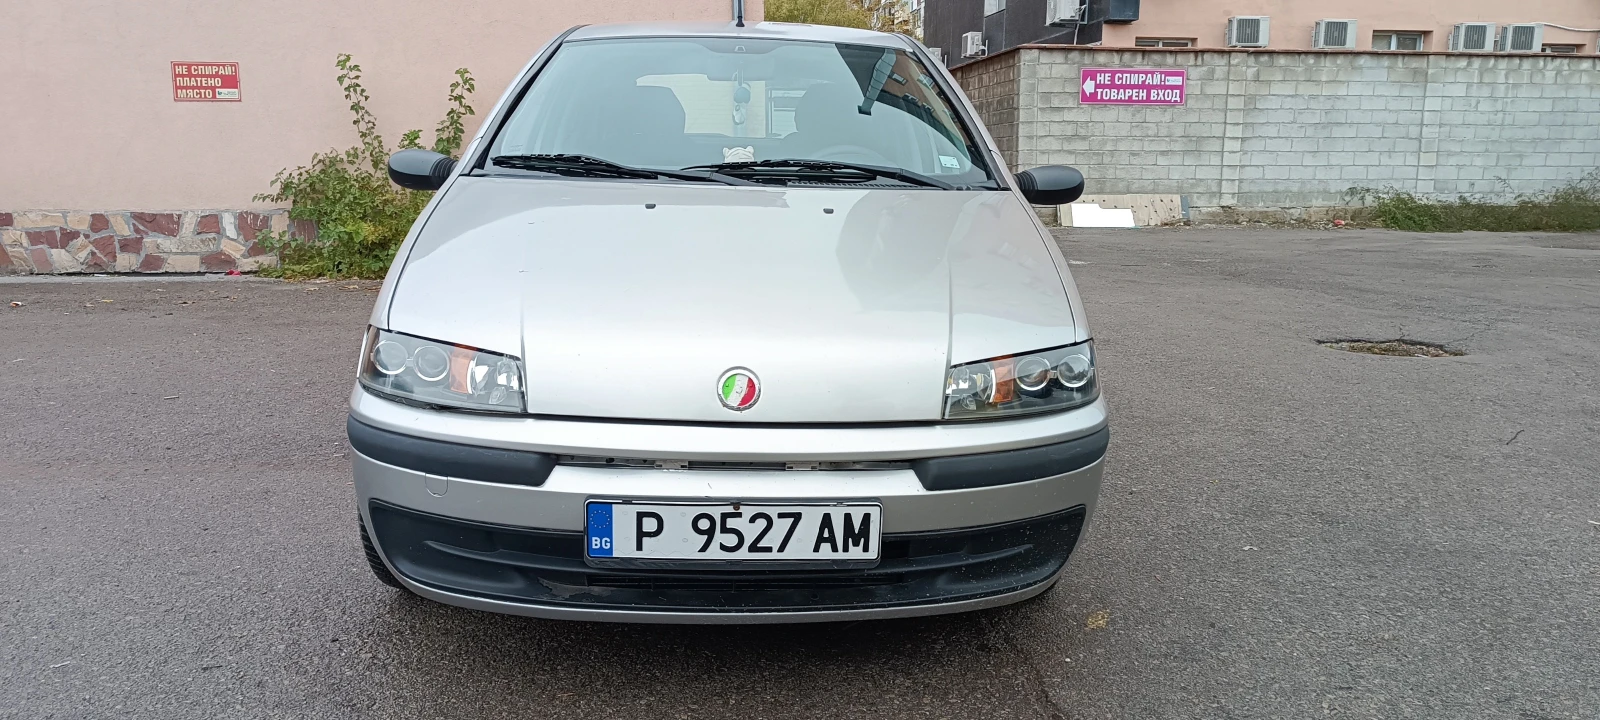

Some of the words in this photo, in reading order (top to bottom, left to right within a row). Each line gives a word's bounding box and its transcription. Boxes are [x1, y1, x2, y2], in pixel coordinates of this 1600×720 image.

[175, 65, 189, 75] НЕ
[191, 65, 236, 75] СПИРАЙ!
[176, 77, 222, 87] ПЛАТЕНО
[1096, 73, 1112, 85] НЕ
[1115, 72, 1165, 86] СПИРАЙ!
[177, 89, 213, 98] МЯСТО
[1096, 88, 1147, 101] ТОВАРЕН
[1150, 89, 1181, 103] ВХОД
[635, 511, 664, 551] P
[691, 511, 803, 553] 9527
[812, 512, 872, 553] AM
[591, 537, 611, 549] BG
